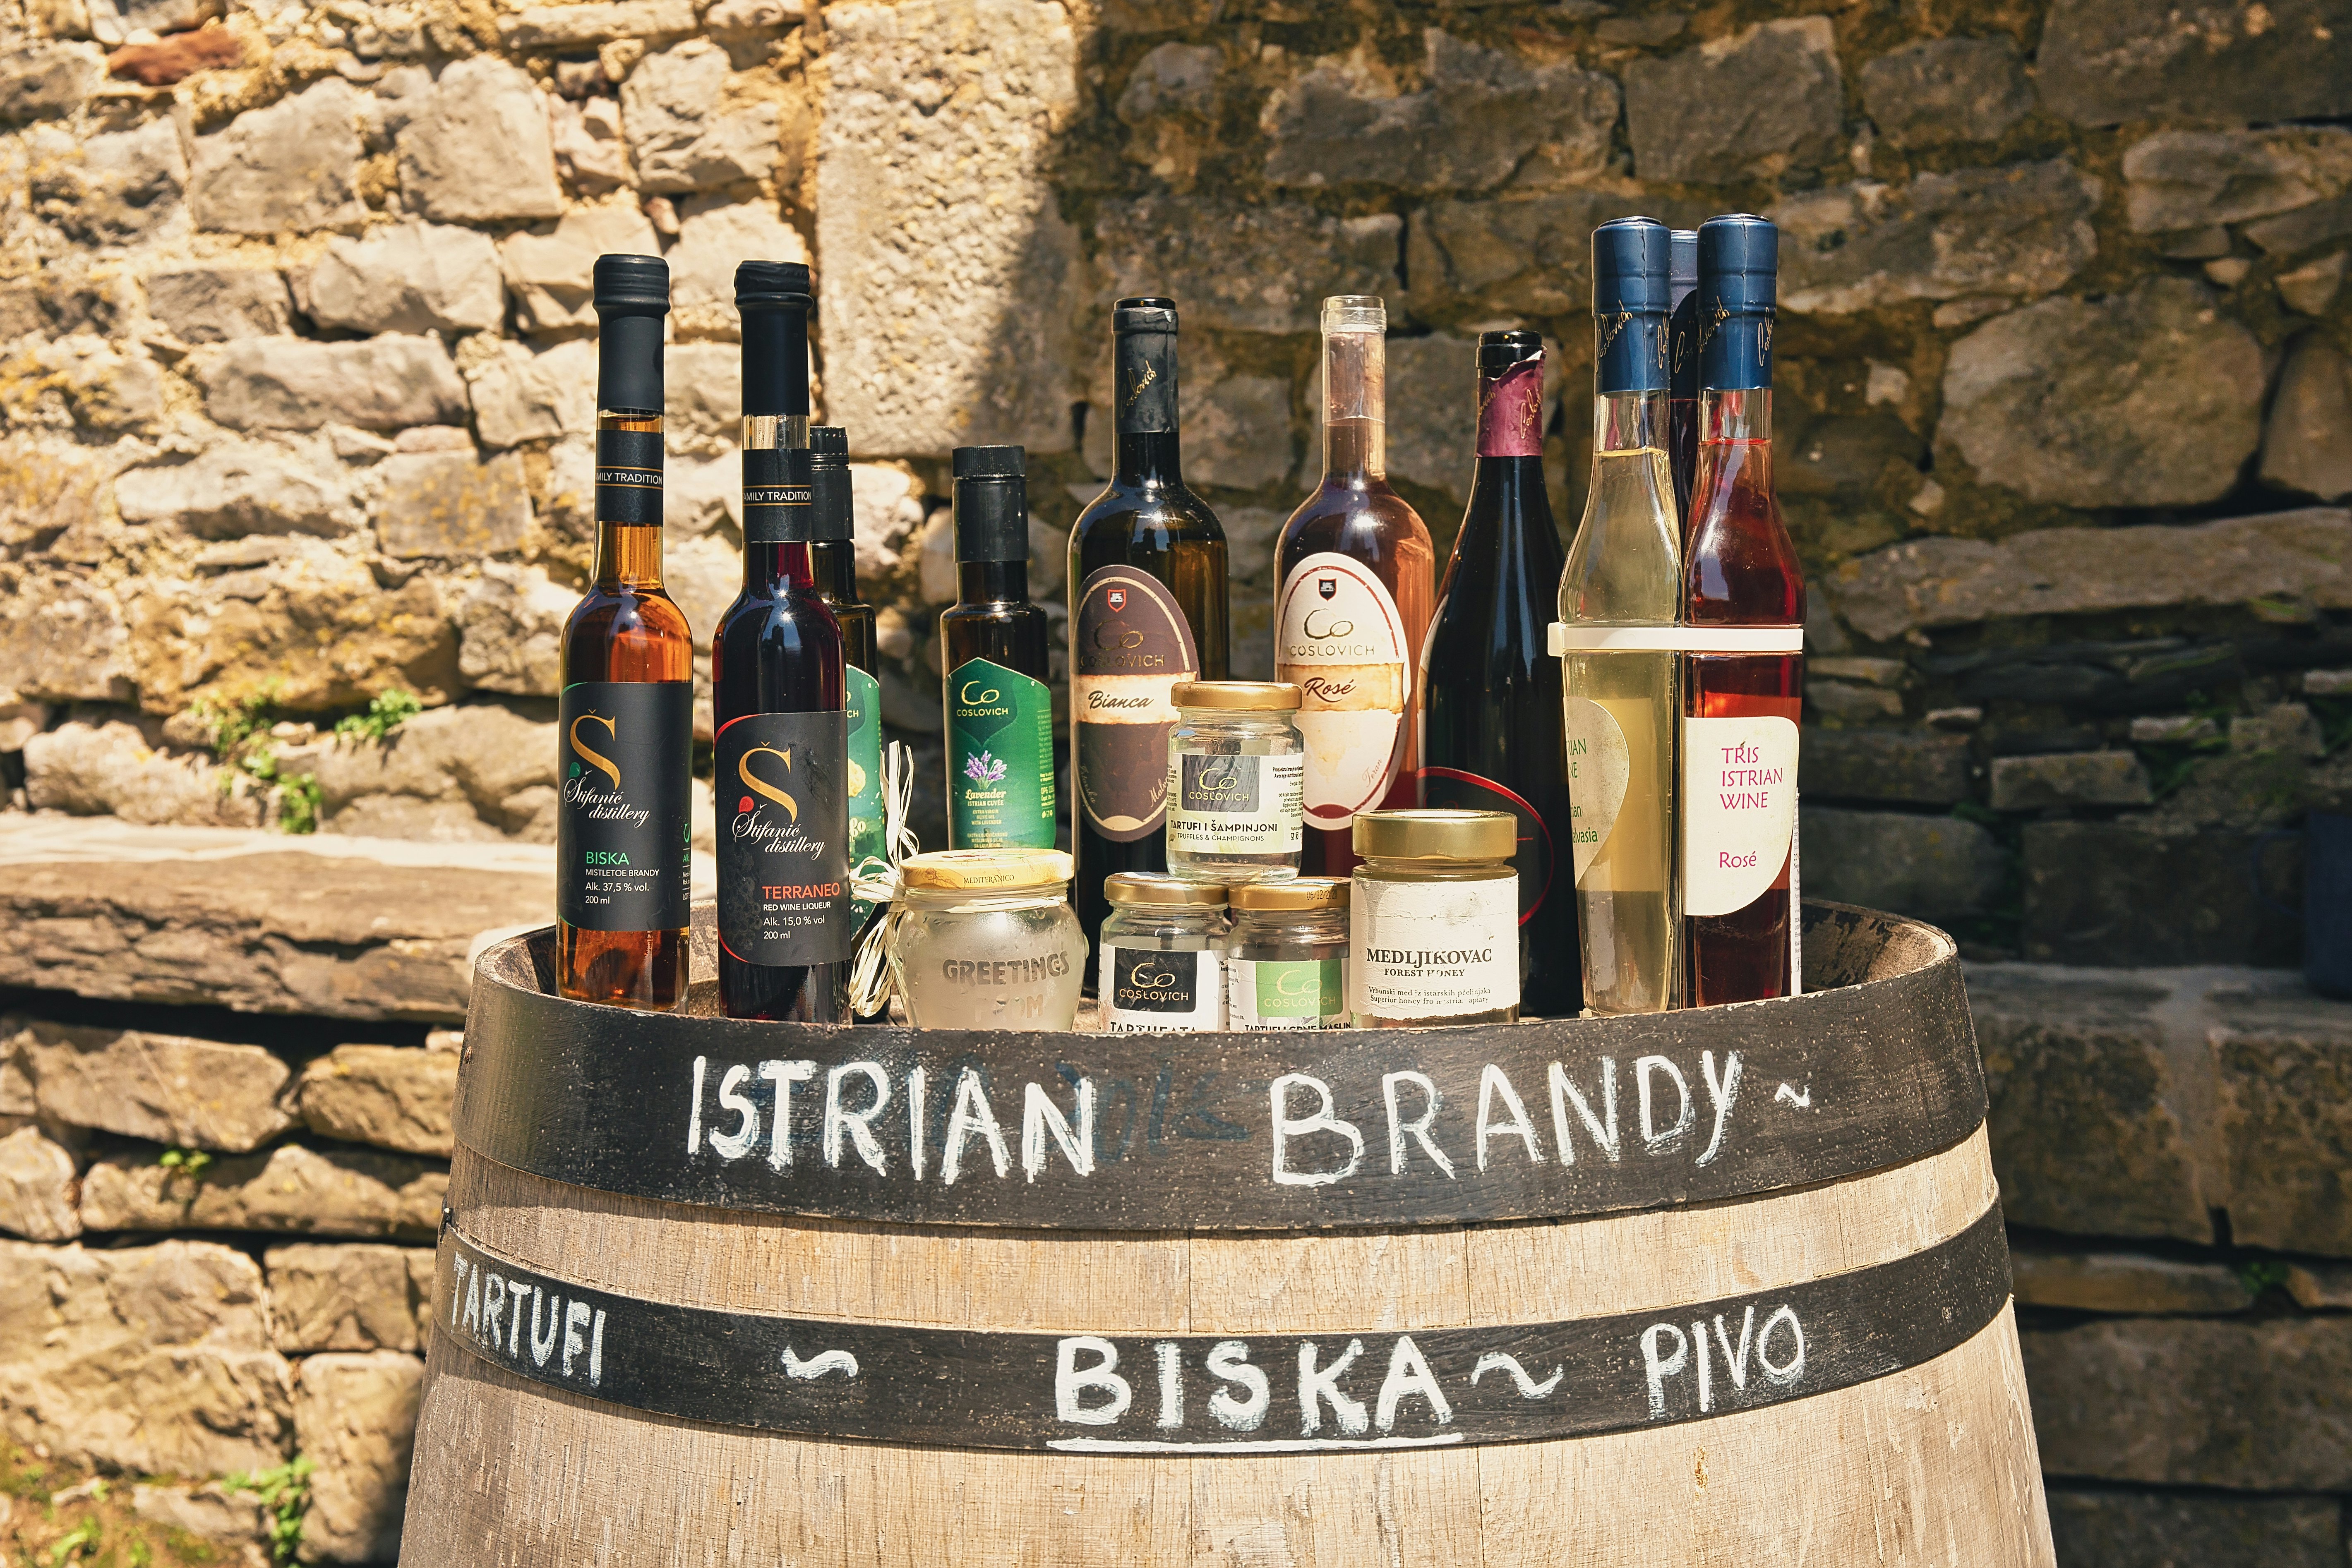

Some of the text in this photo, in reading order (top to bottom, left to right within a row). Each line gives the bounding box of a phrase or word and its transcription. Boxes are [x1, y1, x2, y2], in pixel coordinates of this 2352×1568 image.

[614, 472, 662, 485] TRADITION
[743, 491, 812, 501] AMILY TRADITION
[1290, 645, 1374, 656] COSLOVICH
[1303, 677, 1357, 703] Rosé
[1088, 690, 1154, 710] Bianca
[956, 707, 1008, 717] COSLOVICH
[1721, 746, 1759, 764] TRIS
[1722, 767, 1783, 787] ISTRIAN
[564, 770, 624, 810] Štifanić
[965, 788, 1007, 801] Lavender
[1189, 791, 1249, 801] COSLOVICH
[1719, 791, 1768, 810] WINE
[588, 803, 650, 829] distillery
[732, 803, 802, 845] Štifanić
[1171, 819, 1277, 832] TARTUFI I ŠAMPINJONI
[1573, 826, 1598, 844] alvasia
[764, 836, 826, 861] distillery
[586, 851, 630, 865] BISKA
[1719, 850, 1757, 868] Rosé
[963, 874, 1015, 884] MEDITERANICO
[585, 882, 650, 892] Alk. 37,5 % vol.
[762, 882, 840, 899] TERRANEO
[585, 896, 610, 904] 200 ml
[802, 901, 831, 910] LIQUEUR
[763, 914, 825, 927] Alk. 15,0 % vol
[763, 930, 790, 939] 200 ml
[1366, 948, 1492, 969] MEDLJIKOVAC
[942, 950, 1070, 986] GREETINGS
[1384, 968, 1465, 977] FOREST HONEY
[1119, 988, 1189, 1001] COSLOVICH
[1368, 986, 1395, 995] Vrhunski
[1458, 987, 1490, 997] pčelinjaka
[1264, 996, 1336, 1007] COSLOVCH
[1370, 994, 1397, 1004] Superior
[1399, 997, 1421, 1006] honey
[1469, 996, 1489, 1005] apiary
[687, 1055, 1097, 1185] ISTRIAN
[1270, 1049, 1743, 1186] BRANDY
[450, 1251, 1807, 1436] TARTUFI BISKA PIVO
